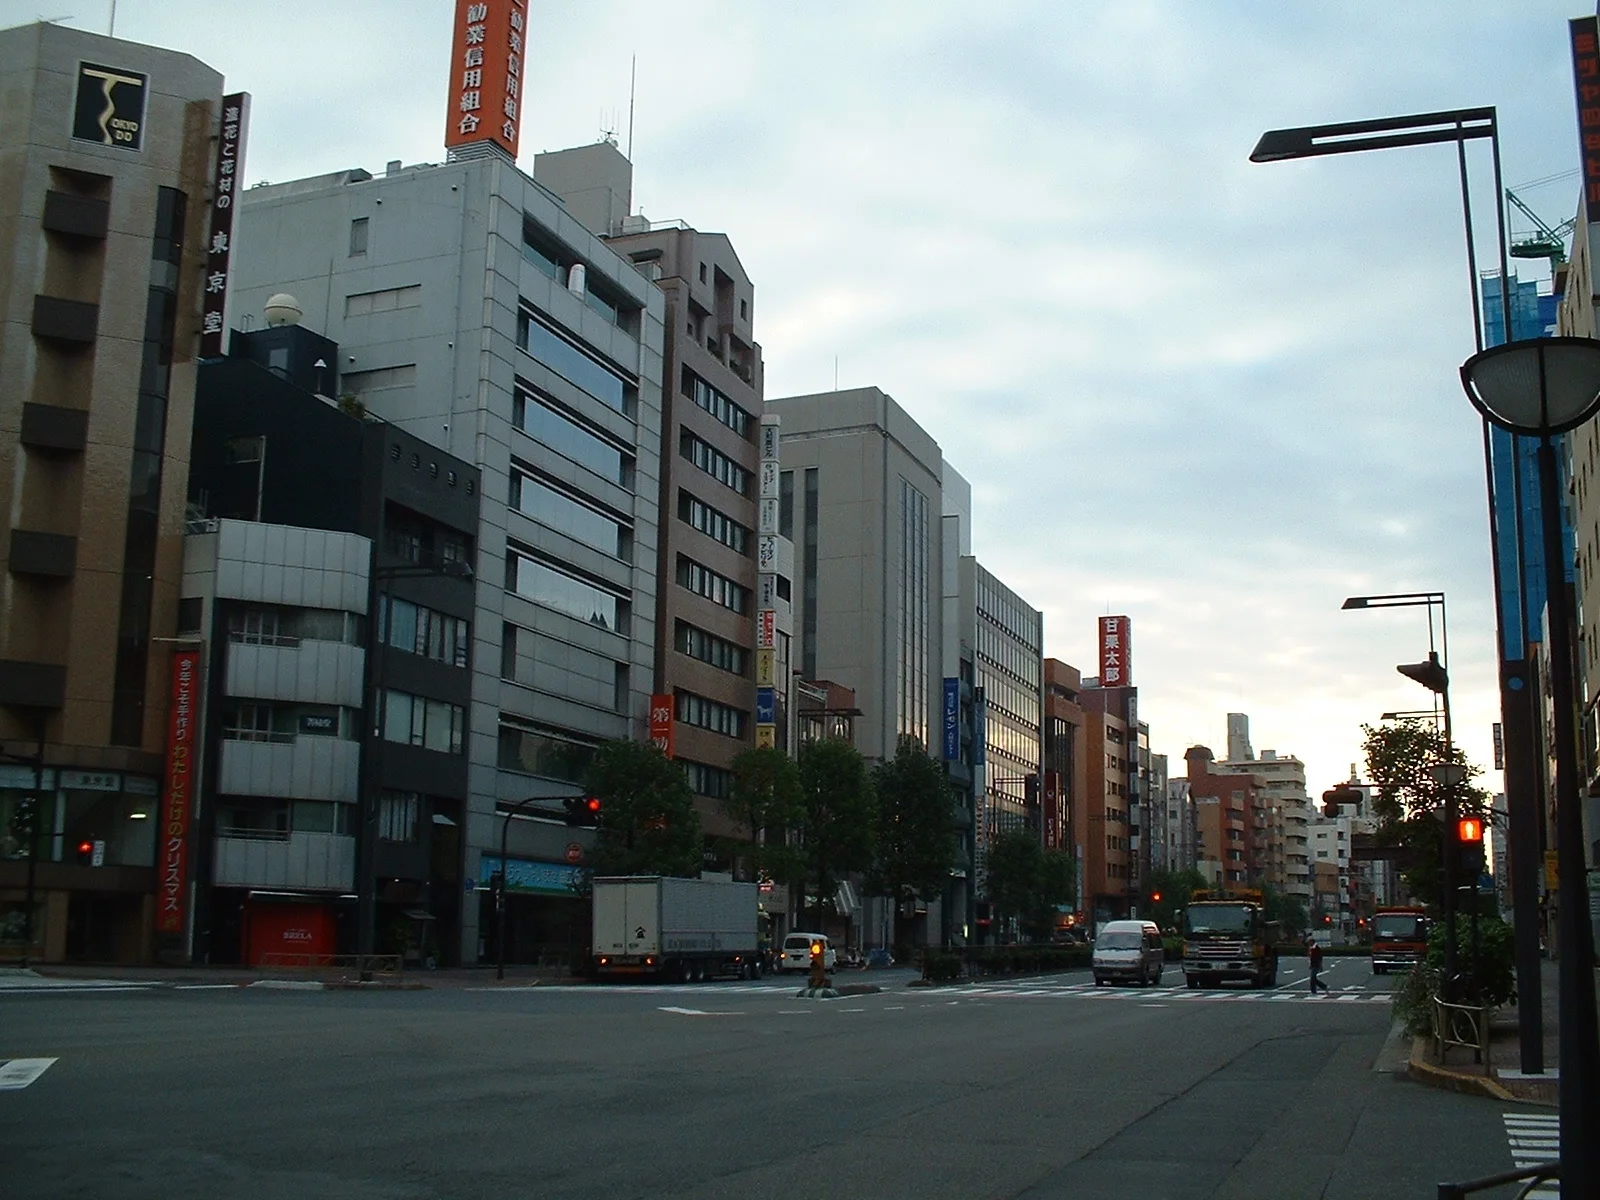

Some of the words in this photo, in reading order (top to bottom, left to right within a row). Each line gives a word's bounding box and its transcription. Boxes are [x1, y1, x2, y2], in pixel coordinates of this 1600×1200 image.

[458, 3, 487, 134] 勧業信用組合
[203, 230, 229, 334] 東京堂
[1104, 618, 1120, 682] 甘栗太郎
